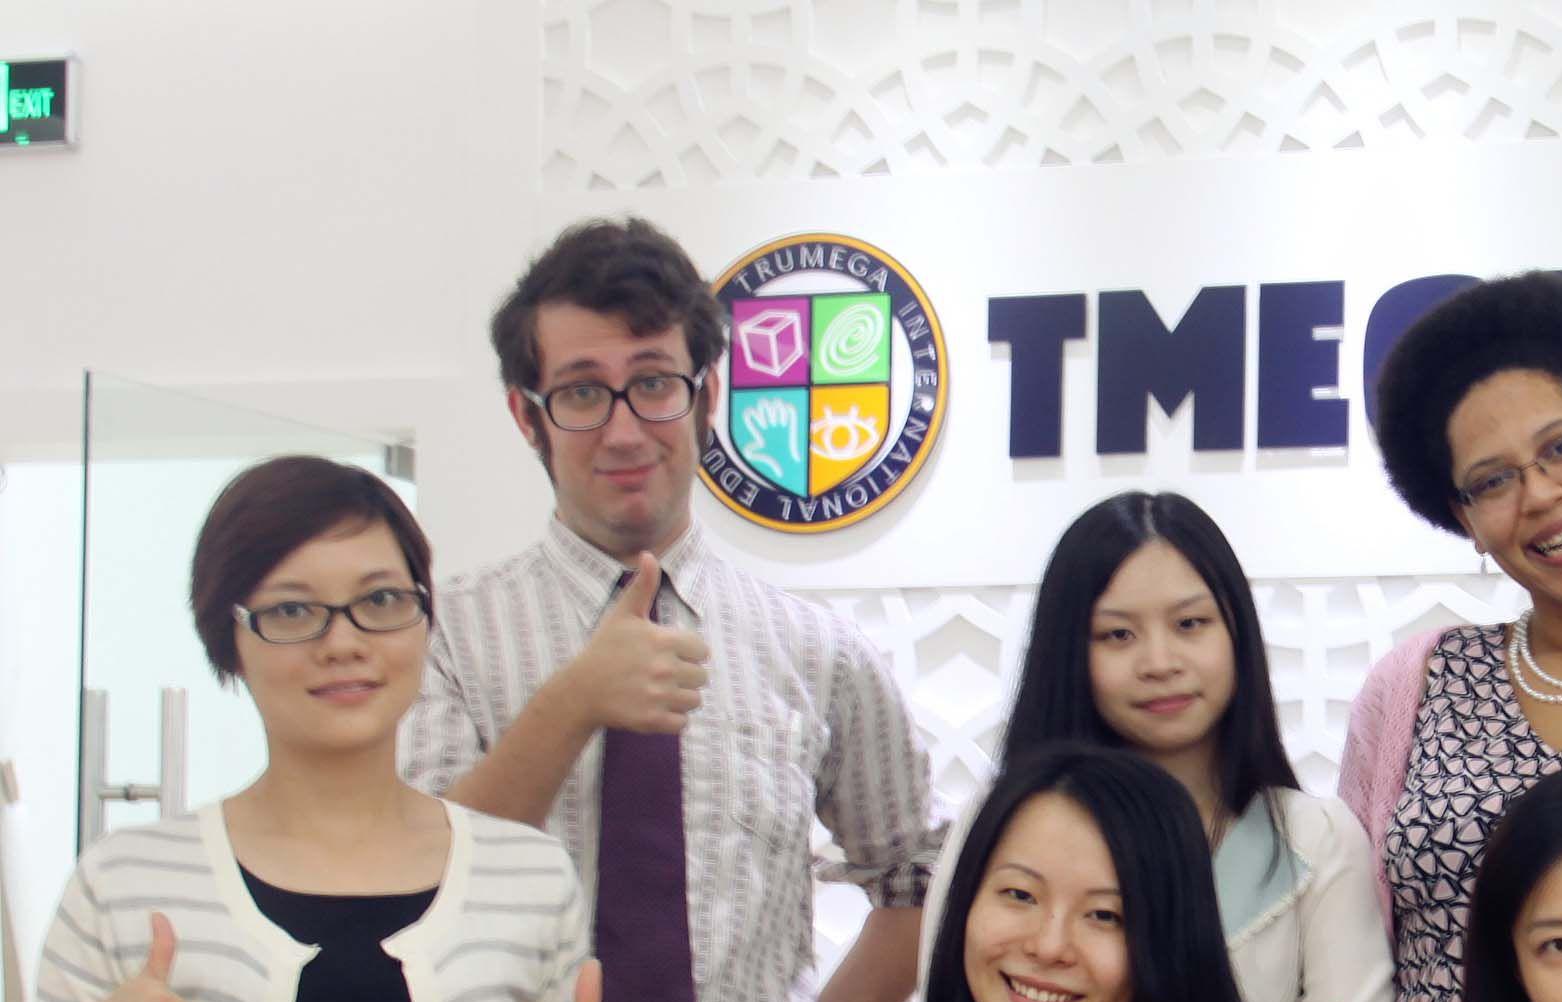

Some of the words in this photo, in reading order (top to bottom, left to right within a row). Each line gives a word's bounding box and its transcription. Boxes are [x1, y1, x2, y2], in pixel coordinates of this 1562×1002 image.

[9, 87, 55, 119] EXIT
[734, 244, 889, 293] TRUMEGA
[776, 300, 939, 521] INTERNATIONAL
